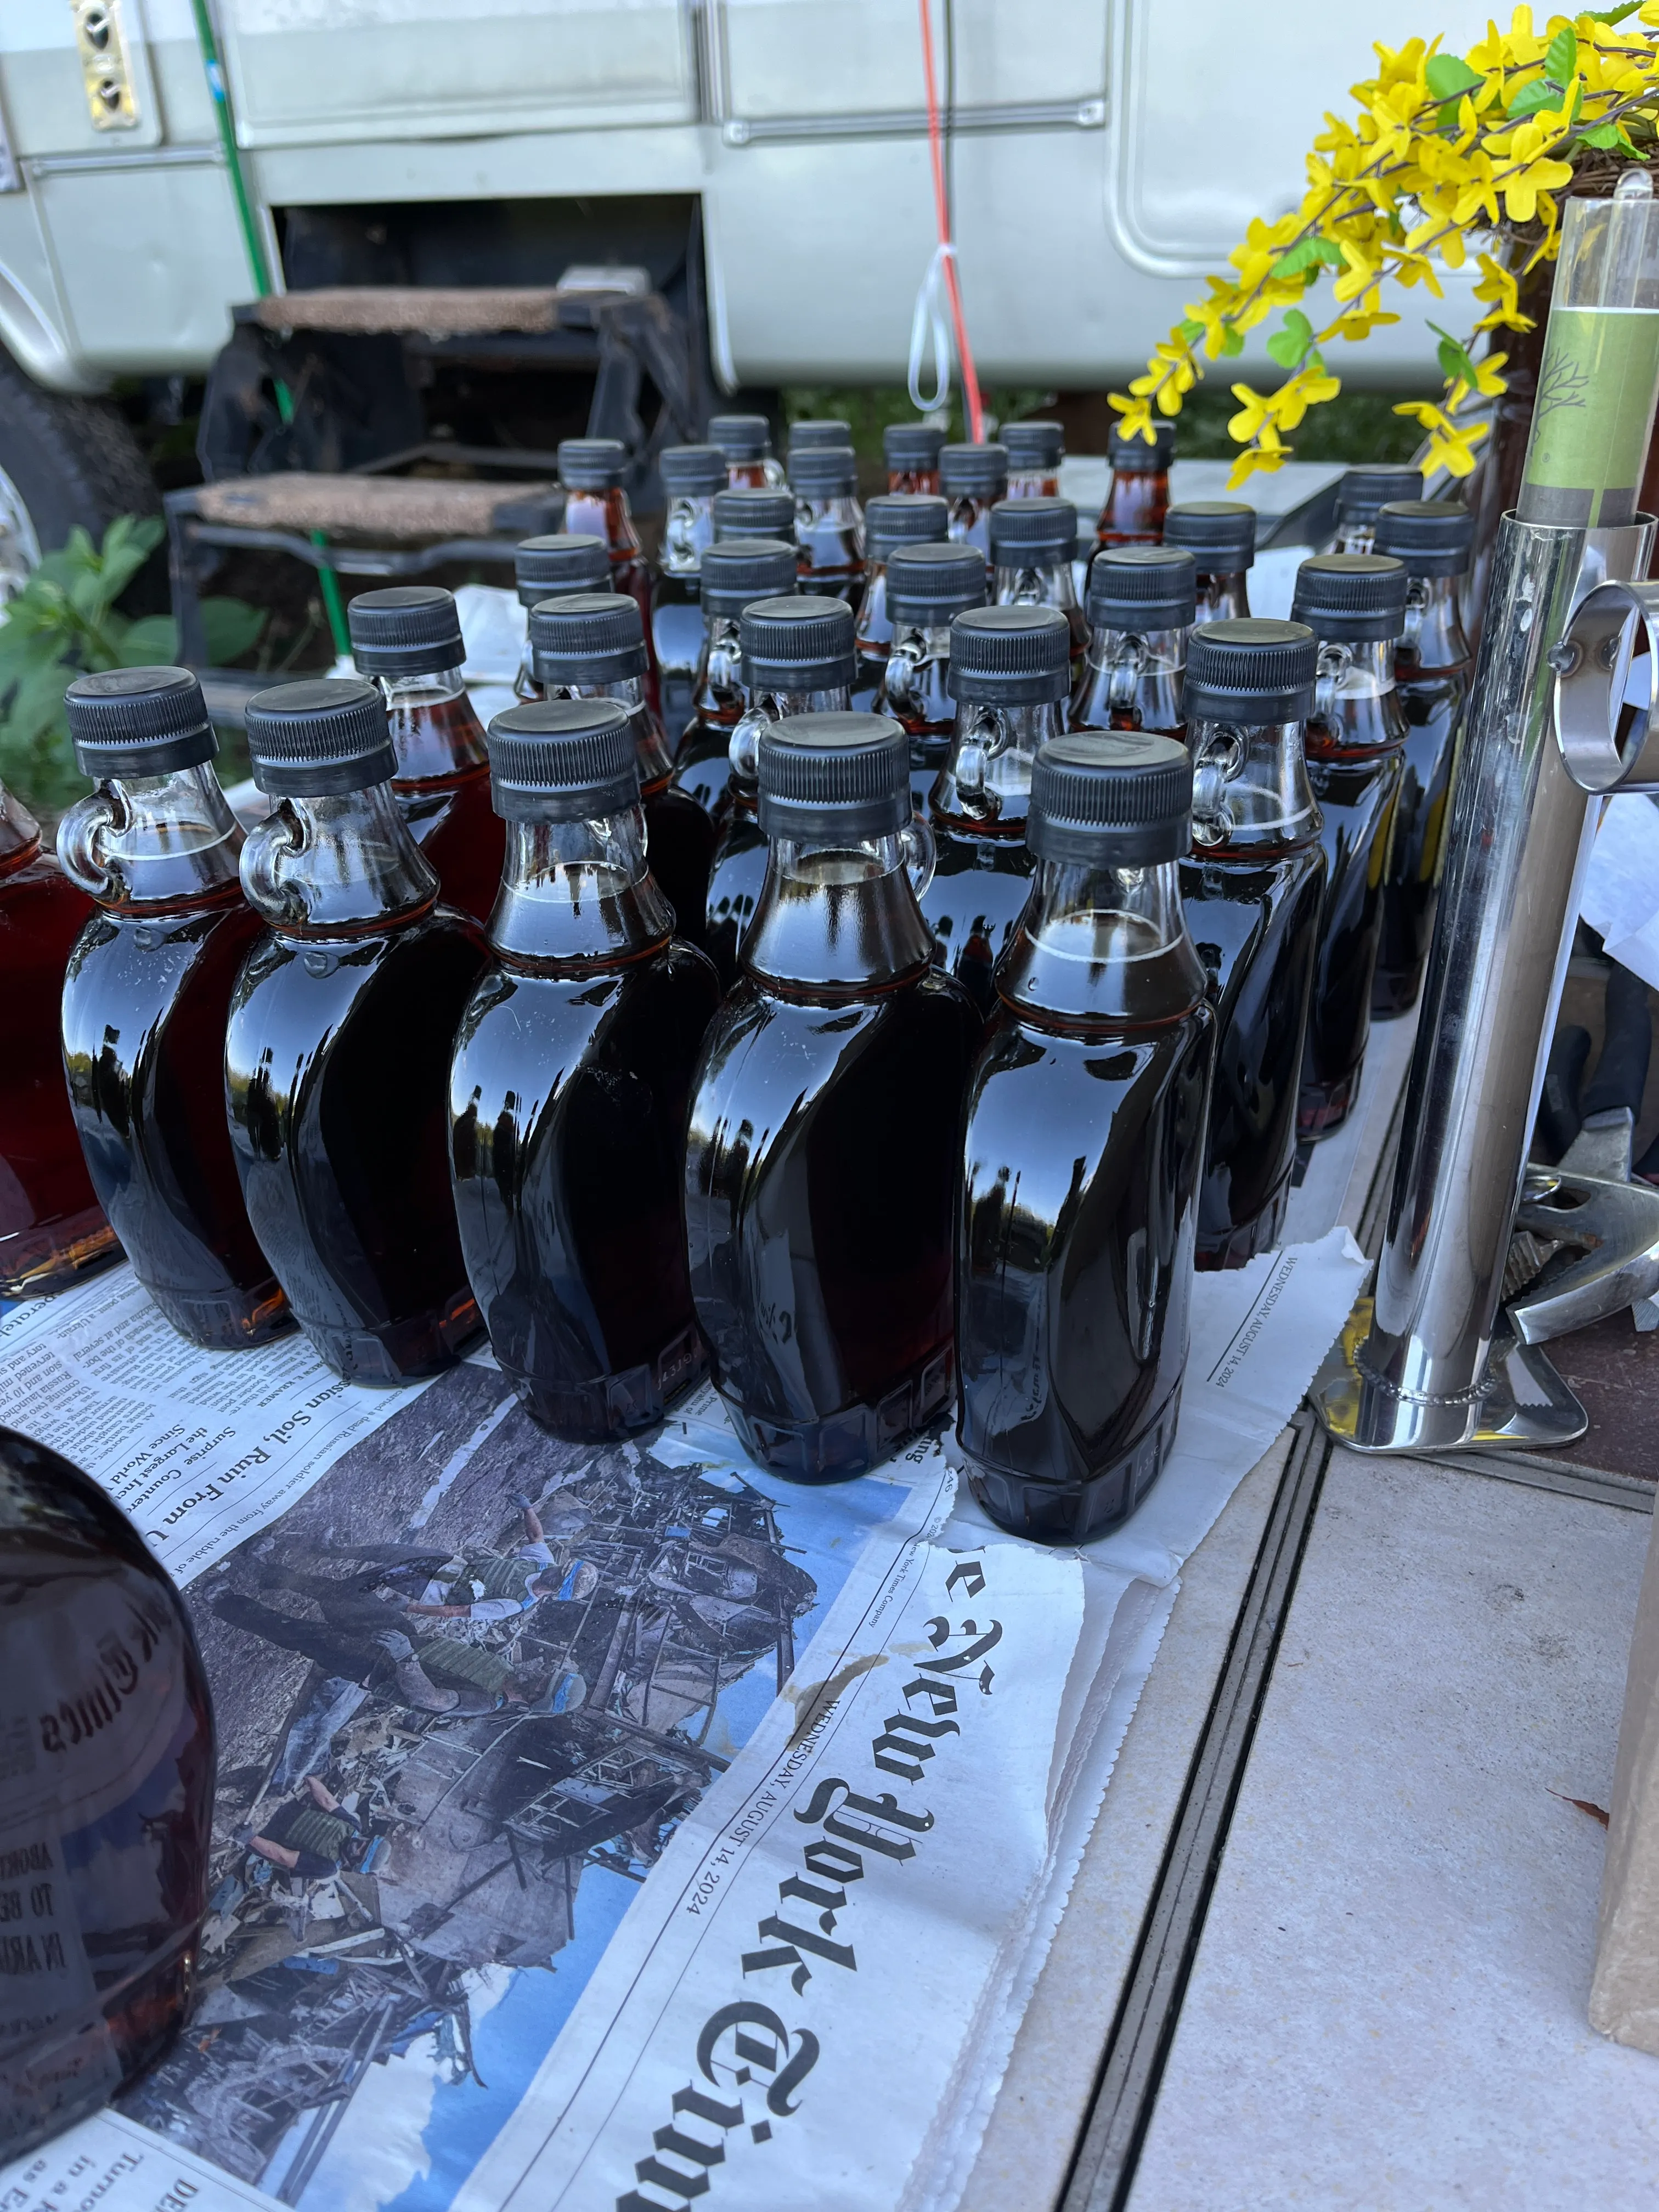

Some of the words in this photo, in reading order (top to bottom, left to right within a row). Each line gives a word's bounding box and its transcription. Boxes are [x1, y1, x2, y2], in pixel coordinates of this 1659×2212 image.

[1257, 1256, 1298, 1319] WEDNESDAY,
[103, 1330, 115, 1339] at
[114, 1320, 130, 1335] and
[1236, 1318, 1266, 1356] AUGUST
[72, 1336, 105, 1362] several
[115, 1338, 126, 1349] of
[136, 1333, 153, 1346] end
[26, 1342, 47, 1359] tory
[99, 1345, 117, 1357] the
[111, 1353, 126, 1363] its
[7, 1355, 26, 1371] and
[14, 1351, 56, 1382] tervened
[43, 1361, 63, 1375] sion
[82, 1355, 103, 1369] bor-
[90, 1362, 113, 1377] first
[100, 1354, 139, 1382] offensive
[24, 1374, 43, 1391] and
[39, 1371, 73, 1394] Russia
[109, 1364, 142, 1385] Russia
[1216, 1364, 1234, 1389] 2024
[13, 1386, 26, 1399] 10
[44, 1379, 81, 1403] coming
[53, 1386, 92, 1412] Ukraine
[80, 1390, 100, 1403] was
[236, 1378, 267, 1400] border
[239, 1393, 259, 1406] that
[256, 1384, 270, 1394] All
[256, 1380, 296, 1408] KRAMER
[0, 1391, 43, 1424] launched
[29, 1401, 49, 1415] two
[40, 1412, 55, 1420] in
[66, 1400, 103, 1422] Taking
[91, 1395, 119, 1416] armor
[95, 1400, 137, 1431] scattered
[96, 1398, 128, 1421] tinkled
[122, 1401, 146, 1419] diers
[126, 1403, 157, 1424] losing
[216, 1398, 238, 1413] post
[228, 1406, 242, 1417] re-
[683, 1407, 693, 1415] of
[695, 1396, 718, 1416] Prime
[10, 1413, 30, 1430] and
[25, 1420, 41, 1431] its
[75, 1416, 93, 1427] lay
[142, 1412, 155, 1421] At
[263, 1409, 312, 1443] Soil,
[346, 1415, 370, 1432] dead
[52, 1421, 70, 1434] the
[61, 1427, 76, 1436] on
[90, 1419, 123, 1444] caught
[100, 1425, 129, 1447] battle
[126, 1422, 144, 1435] the
[148, 1424, 185, 1449] Since
[185, 1426, 208, 1444] the
[78, 1444, 94, 1454] by
[94, 1436, 130, 1460] border,
[183, 1426, 236, 1465] Surprise
[313, 1430, 352, 1460] Russian
[109, 1453, 153, 1485] World
[138, 1441, 190, 1480] Largest
[216, 1445, 271, 1485] Ruin
[285, 1460, 315, 1490] soldier
[161, 1483, 224, 1525] From
[261, 1488, 285, 1509] away
[236, 1508, 263, 1526] from
[219, 1523, 239, 1538] the
[185, 1537, 220, 1563] rubble
[175, 1561, 188, 1576] of
[899, 1559, 915, 1574] York
[888, 1573, 906, 1594] Times
[868, 1595, 893, 1628] Company
[871, 1616, 1003, 1786] New
[770, 1700, 840, 1790] WEDNESDAY,
[728, 1790, 778, 1847] AUGUST
[709, 1846, 735, 1866] 14,
[686, 1871, 720, 1916] 2024
[740, 1777, 936, 1999] York
[67, 2154, 97, 2178] in
